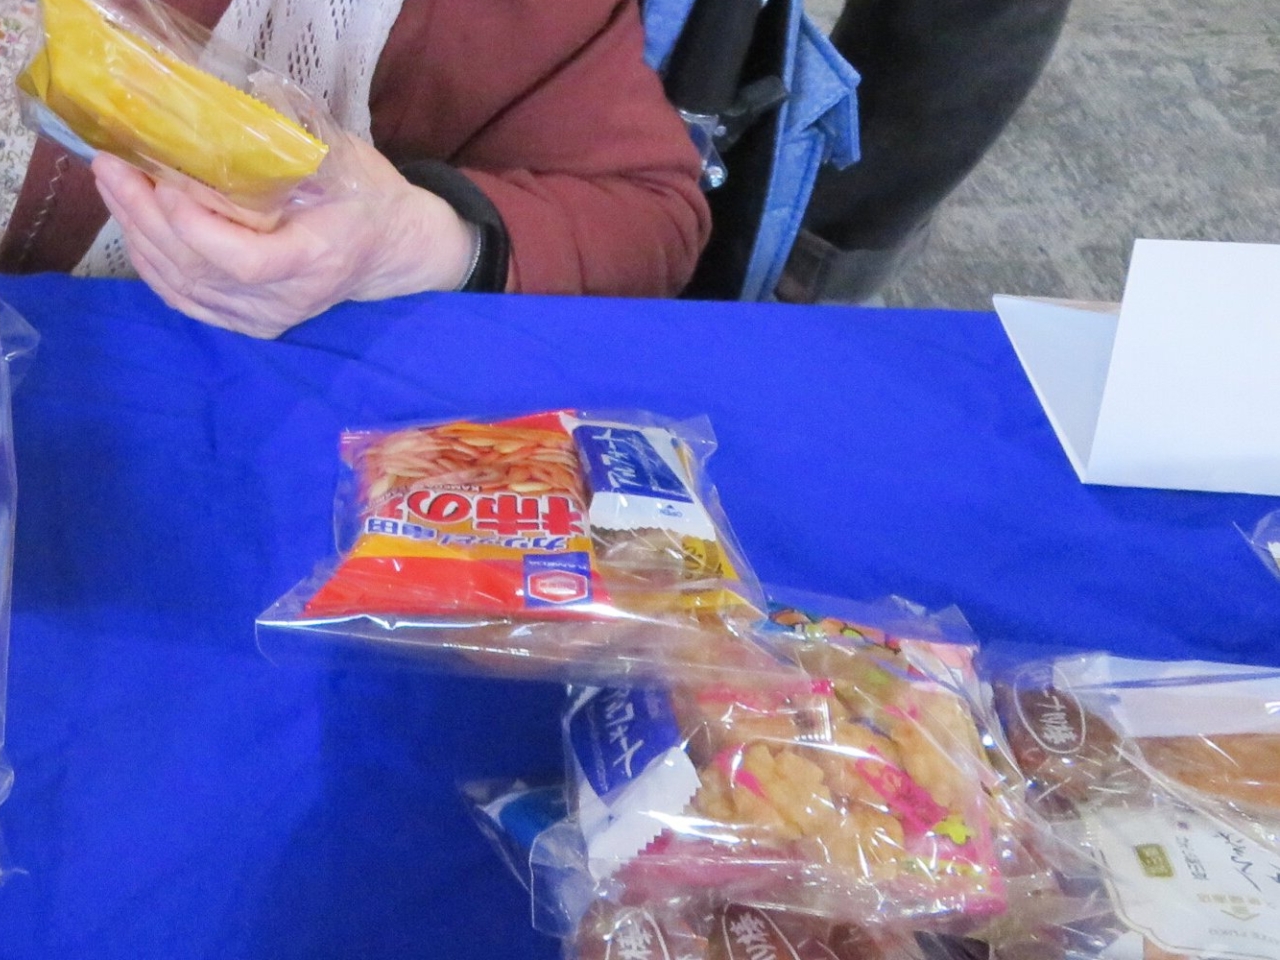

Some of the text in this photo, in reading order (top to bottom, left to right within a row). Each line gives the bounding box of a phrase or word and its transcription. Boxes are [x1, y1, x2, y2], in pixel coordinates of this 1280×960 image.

[592, 426, 637, 494] アルフォート
